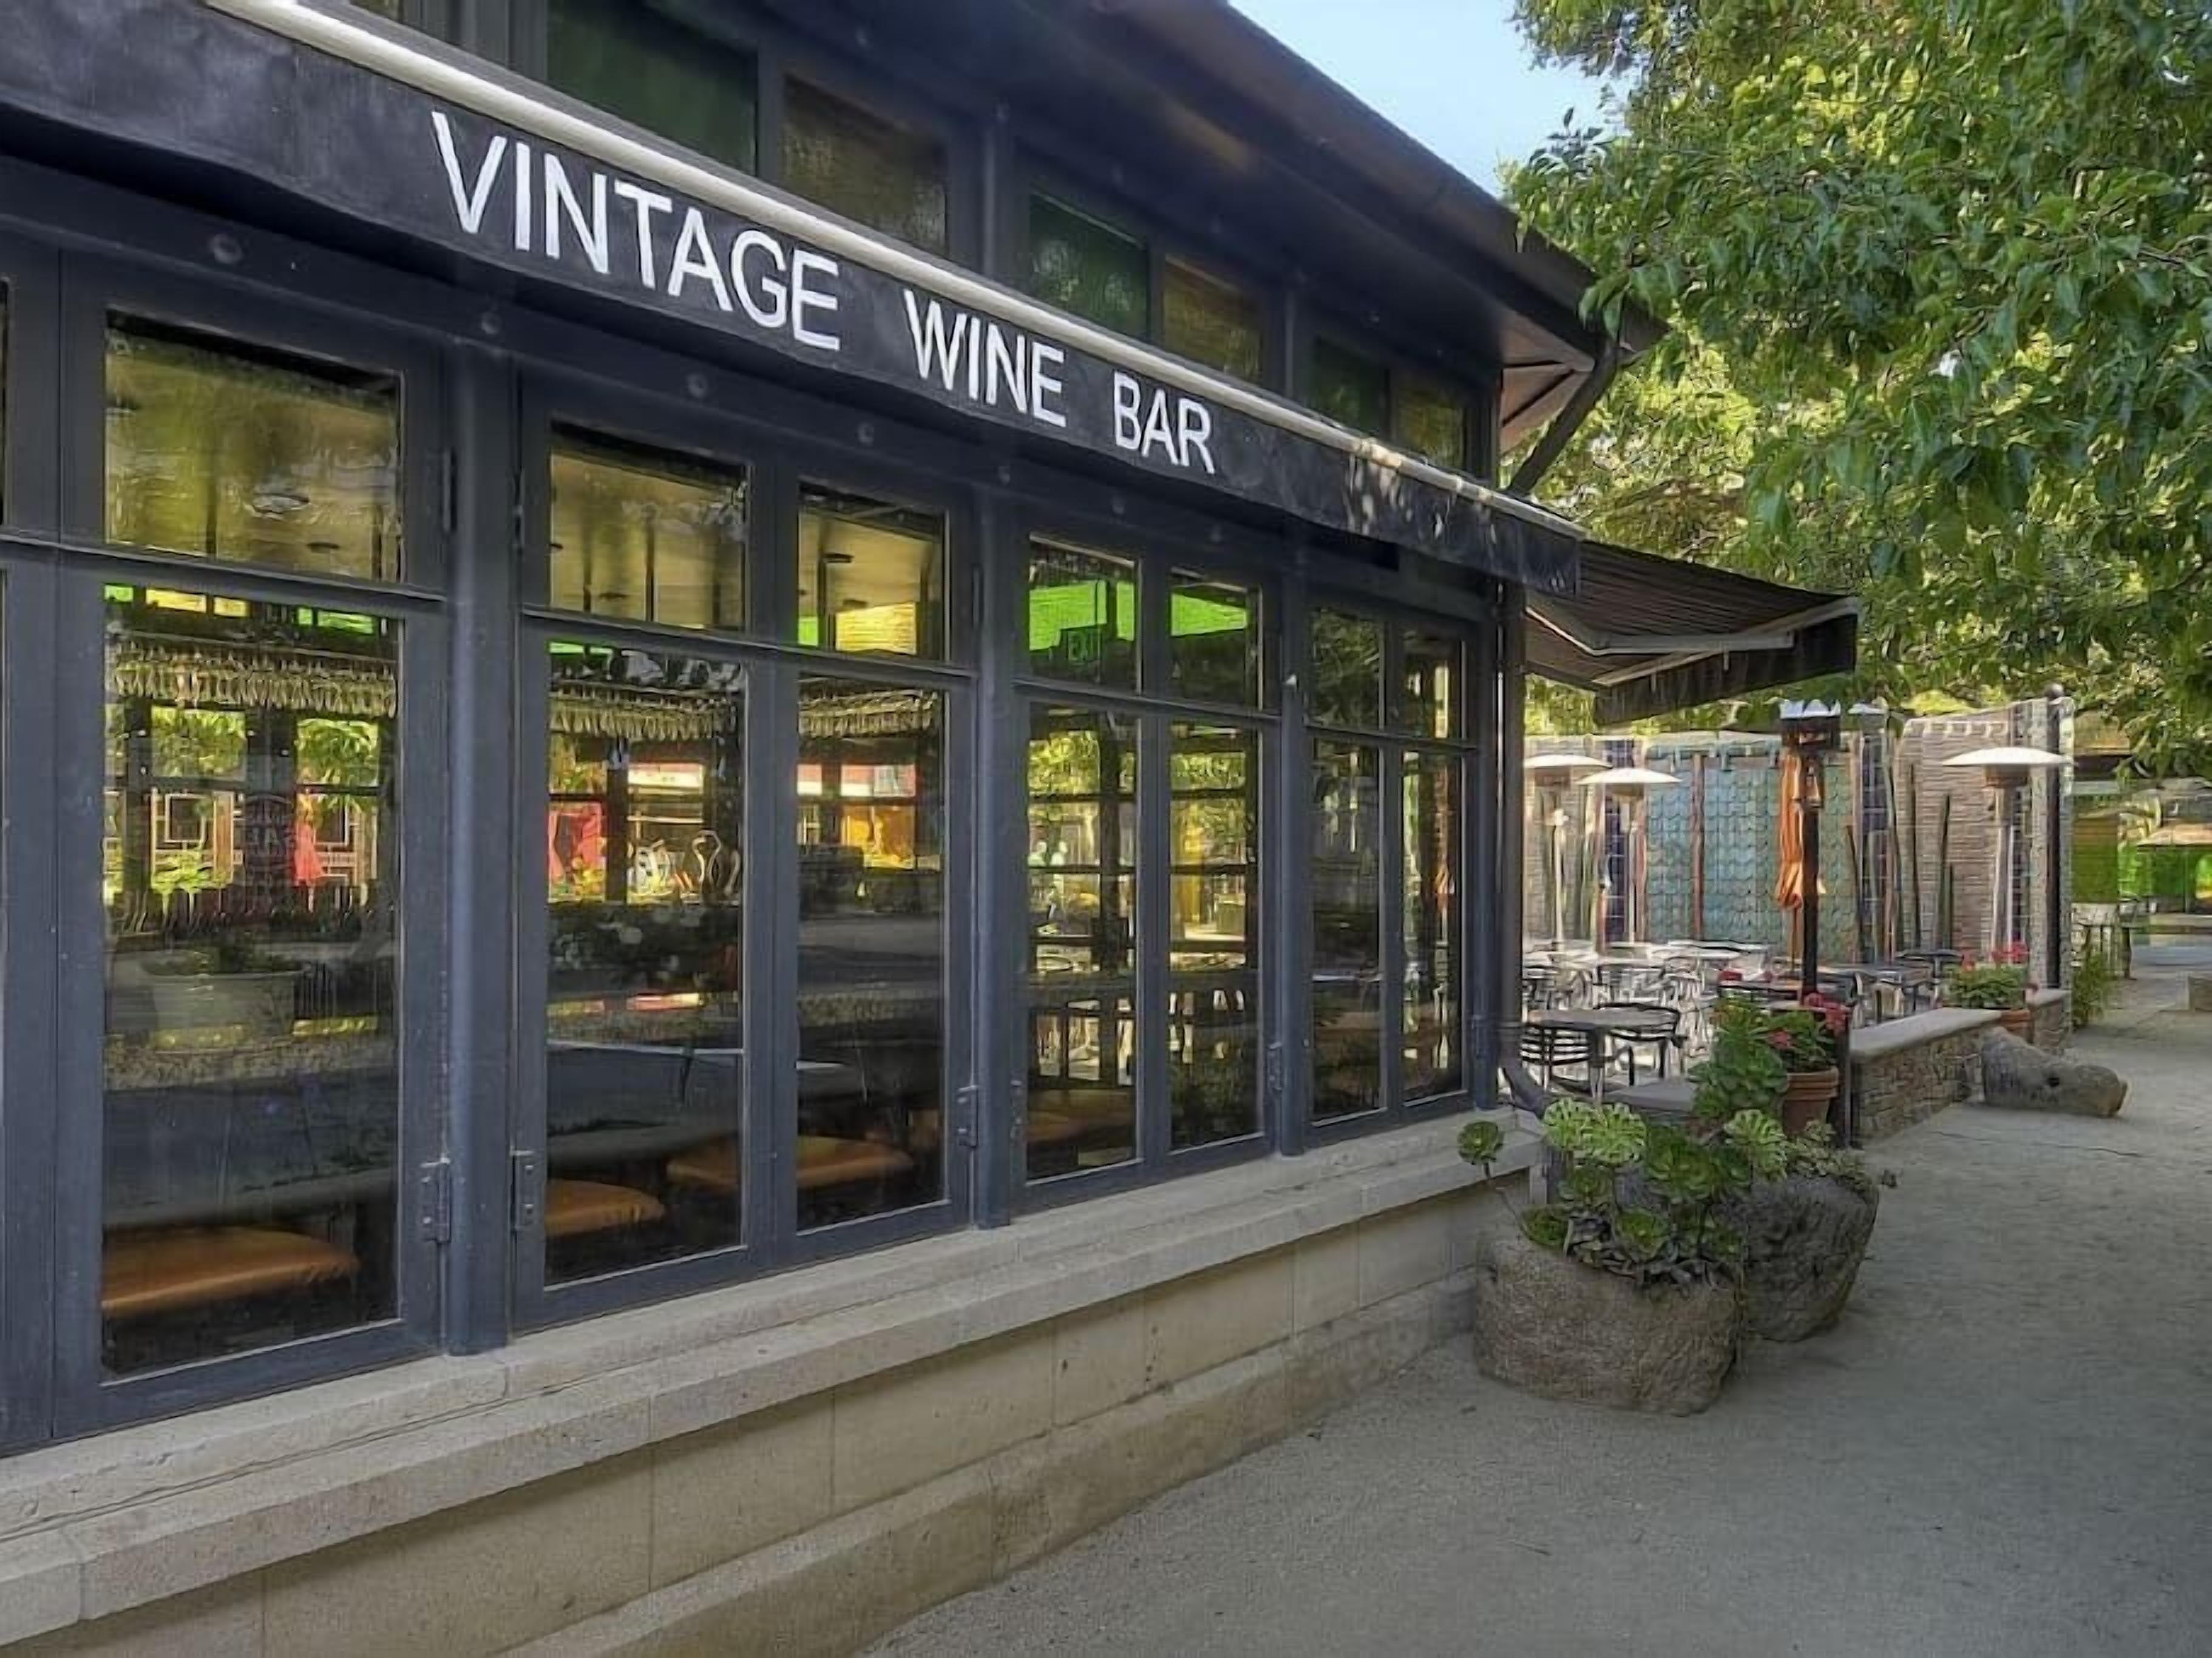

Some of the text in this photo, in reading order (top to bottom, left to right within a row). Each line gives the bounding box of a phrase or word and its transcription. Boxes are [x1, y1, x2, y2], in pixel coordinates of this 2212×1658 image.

[430, 110, 1215, 475] VINTAGE WINE BAR
